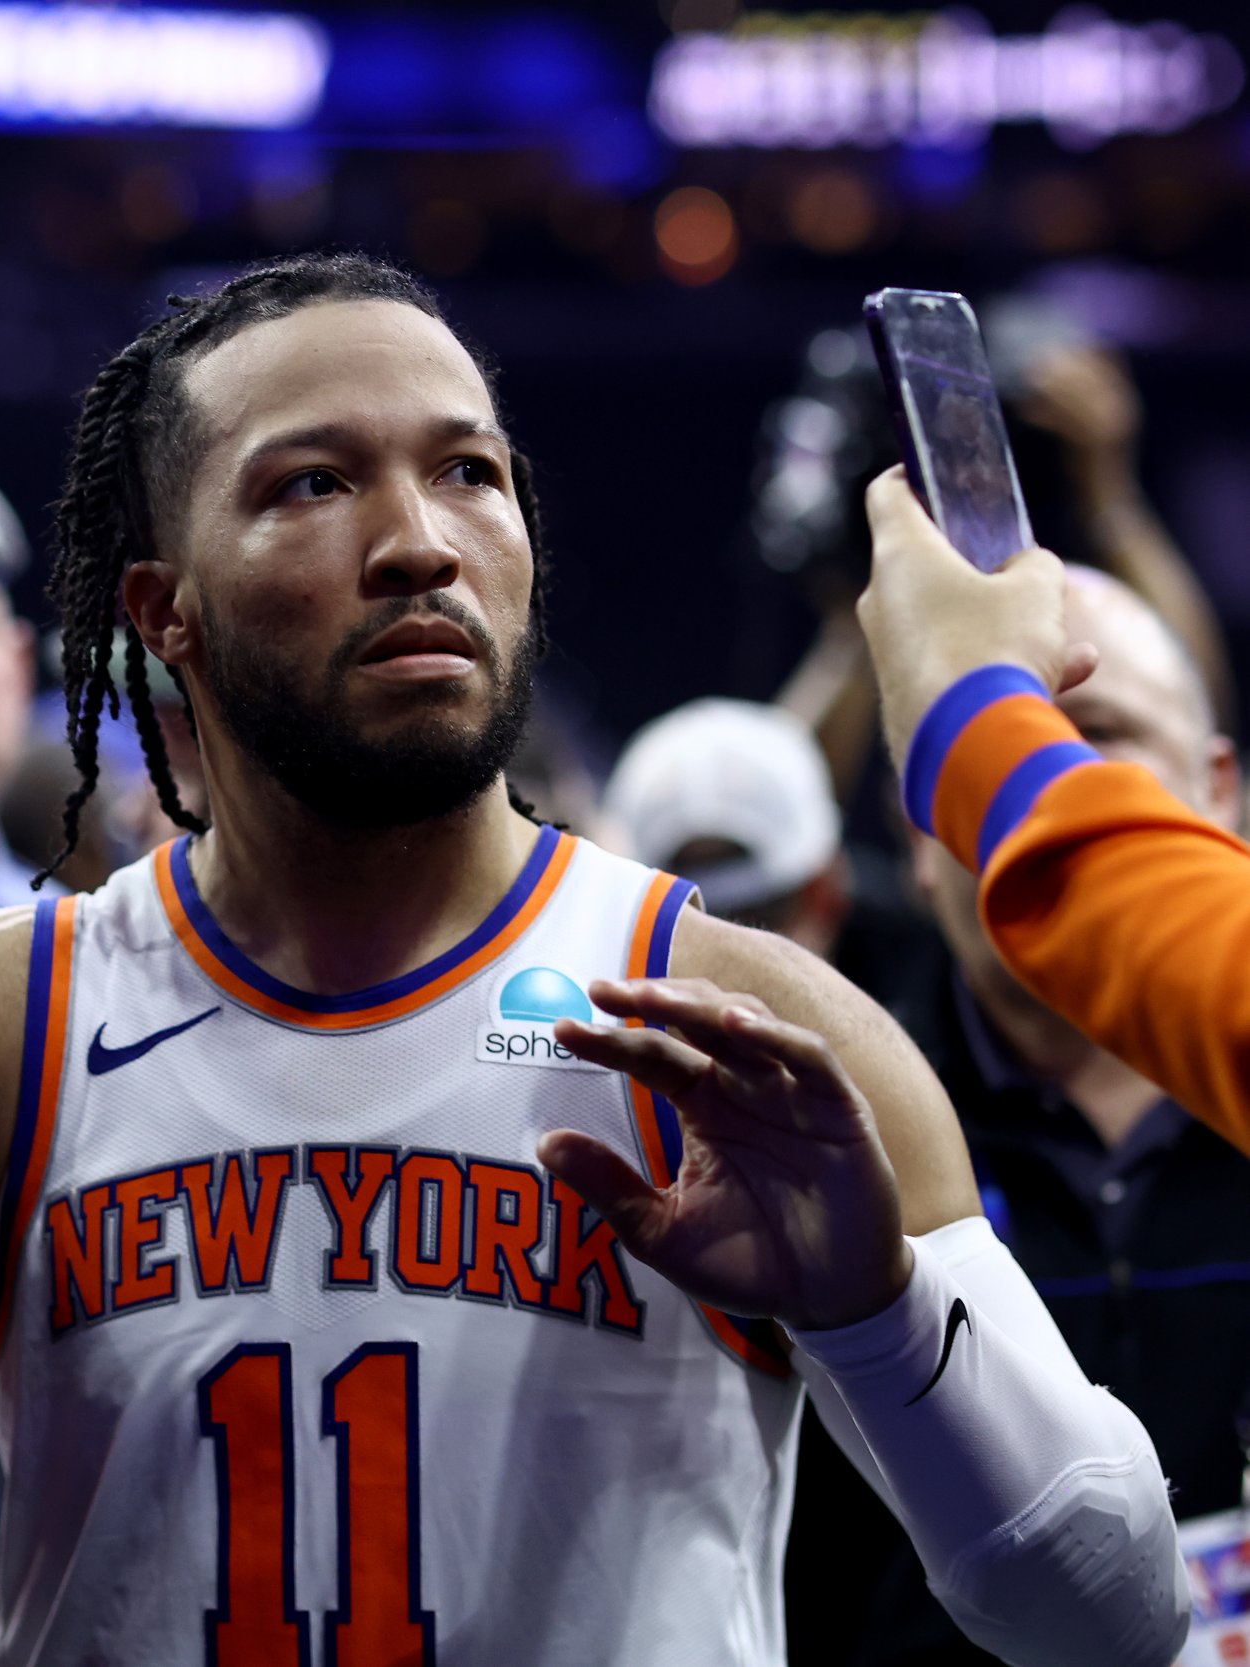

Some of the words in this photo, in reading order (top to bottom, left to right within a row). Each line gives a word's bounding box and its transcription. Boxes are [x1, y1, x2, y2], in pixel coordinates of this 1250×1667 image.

[485, 1030, 581, 1061] sphe
[47, 1146, 301, 1341] NEW
[302, 1142, 647, 1341] YORK
[197, 1341, 437, 1667] 11
